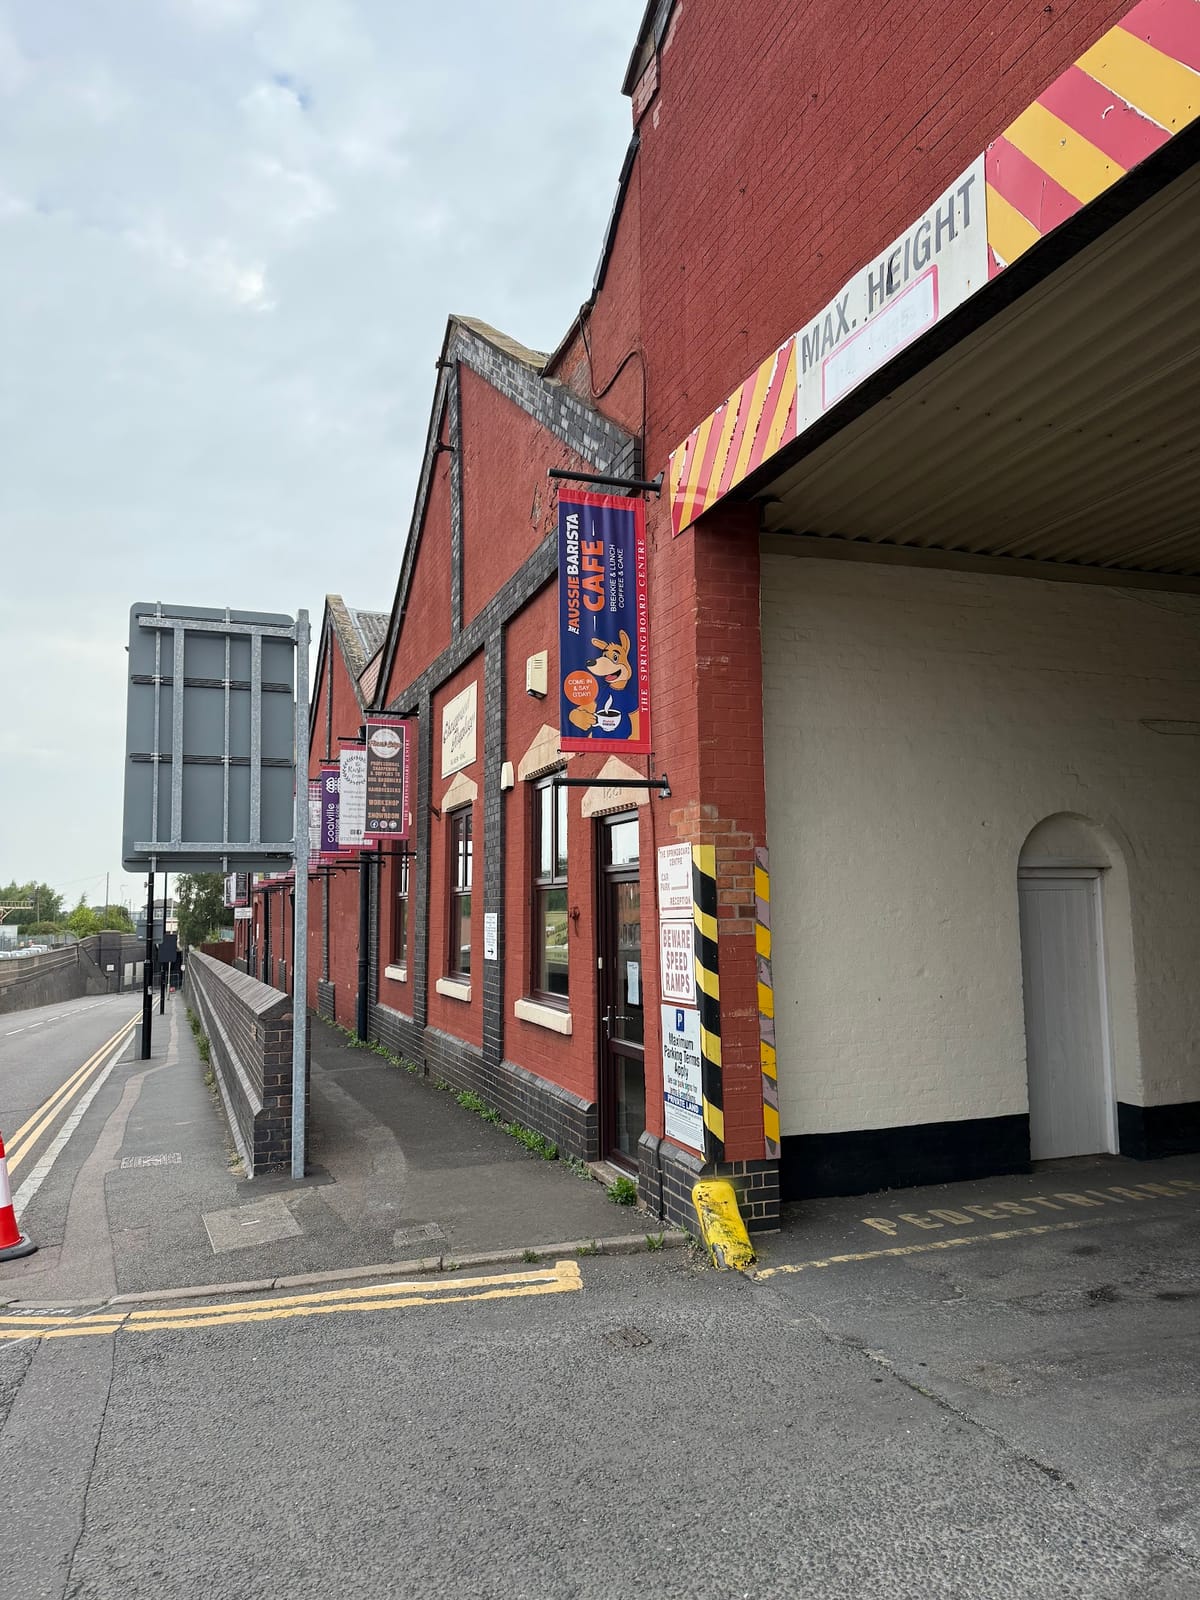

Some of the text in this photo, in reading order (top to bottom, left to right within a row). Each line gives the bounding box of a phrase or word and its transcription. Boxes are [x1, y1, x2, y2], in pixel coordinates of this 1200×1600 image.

[801, 173, 976, 375] MAX. HEIGHT
[566, 513, 579, 575] BARISTA
[638, 538, 646, 587] CENTRE
[581, 540, 606, 612] CAFE
[568, 576, 580, 628] AUSSIE
[638, 593, 648, 682] SPRINGBOARD
[326, 803, 335, 842] coalville
[660, 882, 670, 890] PARK
[670, 896, 690, 905] RECEPTION
[663, 929, 690, 948] BEWARE
[666, 950, 688, 971] SPEED
[666, 972, 690, 994] RAMPS
[678, 1013, 683, 1028] P
[668, 1032, 694, 1050] Maximum
[664, 1044, 700, 1068] Parking Terms
[674, 1062, 688, 1080] Apply
[667, 1094, 686, 1108] PRIVATE
[686, 1101, 699, 1114] LAND
